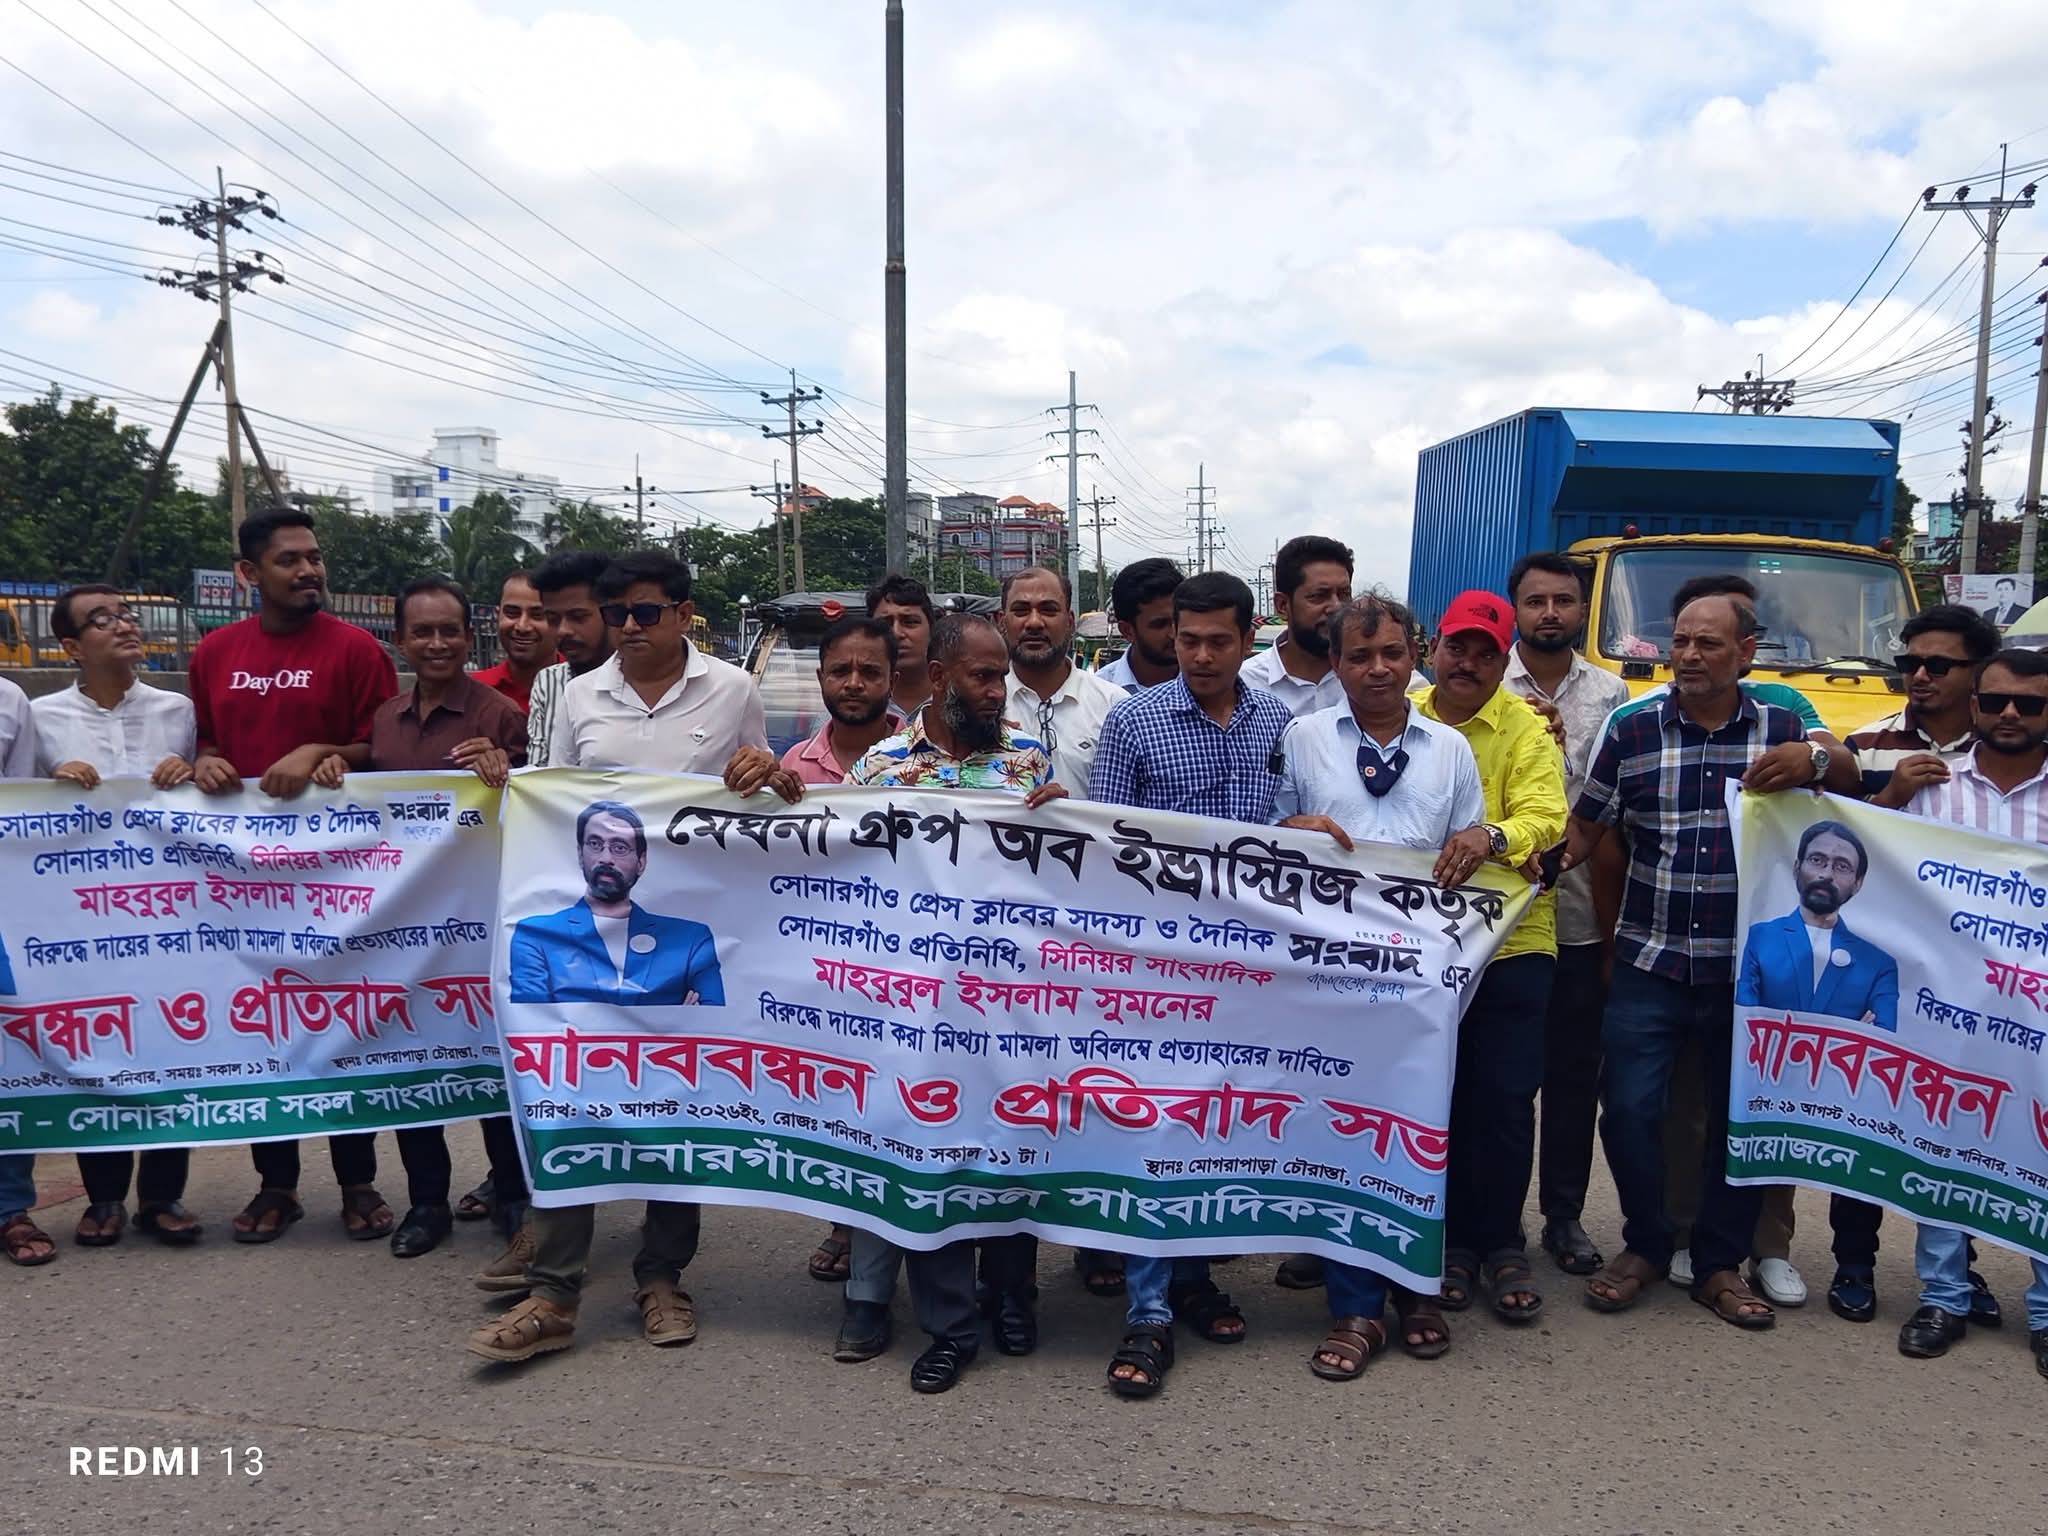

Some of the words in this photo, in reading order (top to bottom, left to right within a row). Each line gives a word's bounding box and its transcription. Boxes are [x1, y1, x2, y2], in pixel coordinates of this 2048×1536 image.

[229, 671, 273, 696] Day
[275, 669, 313, 689] Off
[123, 808, 164, 832] প্রেস
[170, 811, 238, 836] ক্লাবের
[244, 814, 299, 837] সদস্য
[306, 814, 321, 832] ও
[325, 804, 381, 833] দৈনিক
[388, 802, 450, 821] সংবাদ
[457, 810, 484, 828] এর
[665, 805, 840, 856] মেঘনা
[850, 802, 970, 867] গ্রুপ
[984, 818, 1096, 882] অব
[34, 840, 153, 875] সোনারগাঁও
[163, 841, 247, 874] প্রতিনিধি,
[248, 845, 323, 872] সিনিয়র
[324, 841, 403, 872] সাংবাদিক
[1918, 860, 2047, 908] সোনারগাঁও
[73, 881, 198, 919] মাহবুবুল
[205, 872, 296, 911] ইসলাম
[302, 882, 375, 920] সুমনের
[769, 874, 898, 909] সোনারগাঁও
[910, 892, 965, 920] প্রেস
[971, 897, 1059, 928] ক্লাবের
[1065, 908, 1146, 938] সদস্য
[1156, 920, 1178, 939] ও
[1189, 914, 1277, 952] দৈনিক
[1288, 933, 1423, 977] সংবাদ
[24, 937, 88, 967] বিরুদ্ধে
[93, 934, 150, 960] দায়ের
[155, 929, 191, 954] করা
[197, 923, 240, 954] মিথ্যা
[244, 928, 285, 955] মামলা
[346, 926, 427, 952] প্রত্যাহারের
[431, 918, 487, 945] দাবিতে
[778, 915, 900, 953] সোনারগাঁও
[909, 932, 1026, 973] প্রতিনিধি,
[1038, 939, 1136, 975] সিনিয়র
[1145, 955, 1276, 987] সাংবাদিক
[0, 996, 138, 1061] বন্ধন
[159, 992, 207, 1041] ও
[231, 968, 415, 1047] প্রতিবাদ
[812, 958, 945, 1013] মাহবুবুল
[955, 970, 1083, 1016] ইসলাম
[1091, 987, 1220, 1025] সুমনের
[1915, 987, 1982, 1037] বিরুদ্ধে
[1986, 1014, 2046, 1055] দায়ের
[758, 990, 822, 1030] বিরুদ্ধে
[826, 1009, 885, 1041] দায়ের
[889, 1020, 926, 1052] করা
[932, 1022, 990, 1056] মিথ্যা
[996, 1031, 1061, 1061] মামলা
[1068, 1030, 1153, 1062] অবিলম্বে
[1159, 1037, 1271, 1068] প্রত্যাহারের
[1277, 1046, 1354, 1077] দাবিতে
[206, 1062, 242, 1077] সকাল
[248, 1062, 263, 1073] ১১
[267, 1057, 280, 1073] টা
[1746, 1014, 2013, 1139] মানববন্ধন
[68, 1093, 270, 1132] সোনারগাঁয়ের
[277, 1091, 355, 1120] সকল
[360, 1073, 507, 1111] সাংবাদিক
[508, 1028, 876, 1116] মানববন্ধন
[897, 1075, 960, 1124] ও
[994, 1067, 1304, 1140] প্রতিবাদ
[1321, 1099, 1448, 1171] সভ
[1778, 1101, 1796, 1114] ২৯
[1800, 1101, 1843, 1120] আগস্ট
[585, 1103, 612, 1119] ২৯
[619, 1100, 681, 1120] আগস্ট
[929, 1145, 982, 1164] সকাল
[987, 1148, 1011, 1165] ১১
[1018, 1145, 1040, 1167] টা
[1727, 1132, 1861, 1175] আয়োজনে
[541, 1138, 890, 1203] সোনারগাঁয়ের
[899, 1183, 1051, 1218] সকল
[1060, 1185, 1423, 1254] সাংবাদিকবৃন্দ
[1359, 1174, 1436, 1214] সোনারগাঁ
